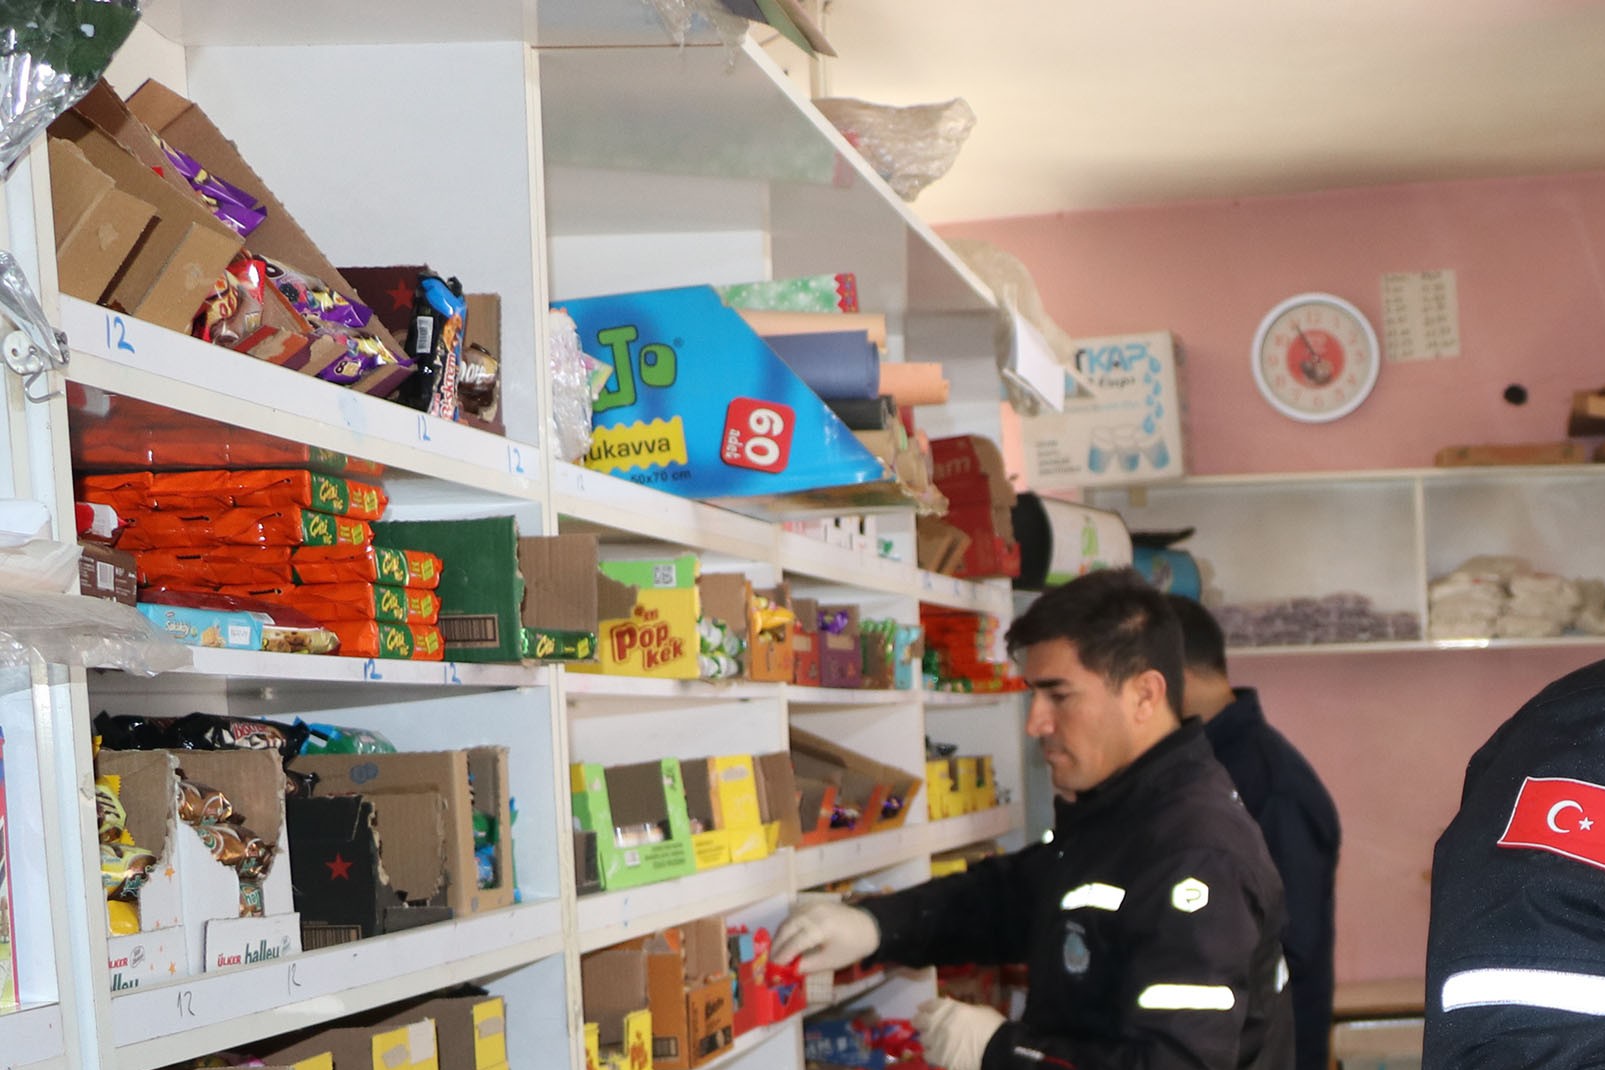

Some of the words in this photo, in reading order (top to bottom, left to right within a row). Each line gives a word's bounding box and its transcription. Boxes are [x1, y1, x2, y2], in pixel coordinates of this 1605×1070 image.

[105, 317, 136, 354] 12
[583, 435, 671, 462] ukavva
[725, 429, 741, 459] adet
[743, 408, 785, 466] 60
[507, 448, 525, 474] 12
[363, 658, 383, 680] 12
[443, 661, 462, 685] 12
[217, 953, 242, 967] ÜLKER
[177, 990, 196, 1017] 12
